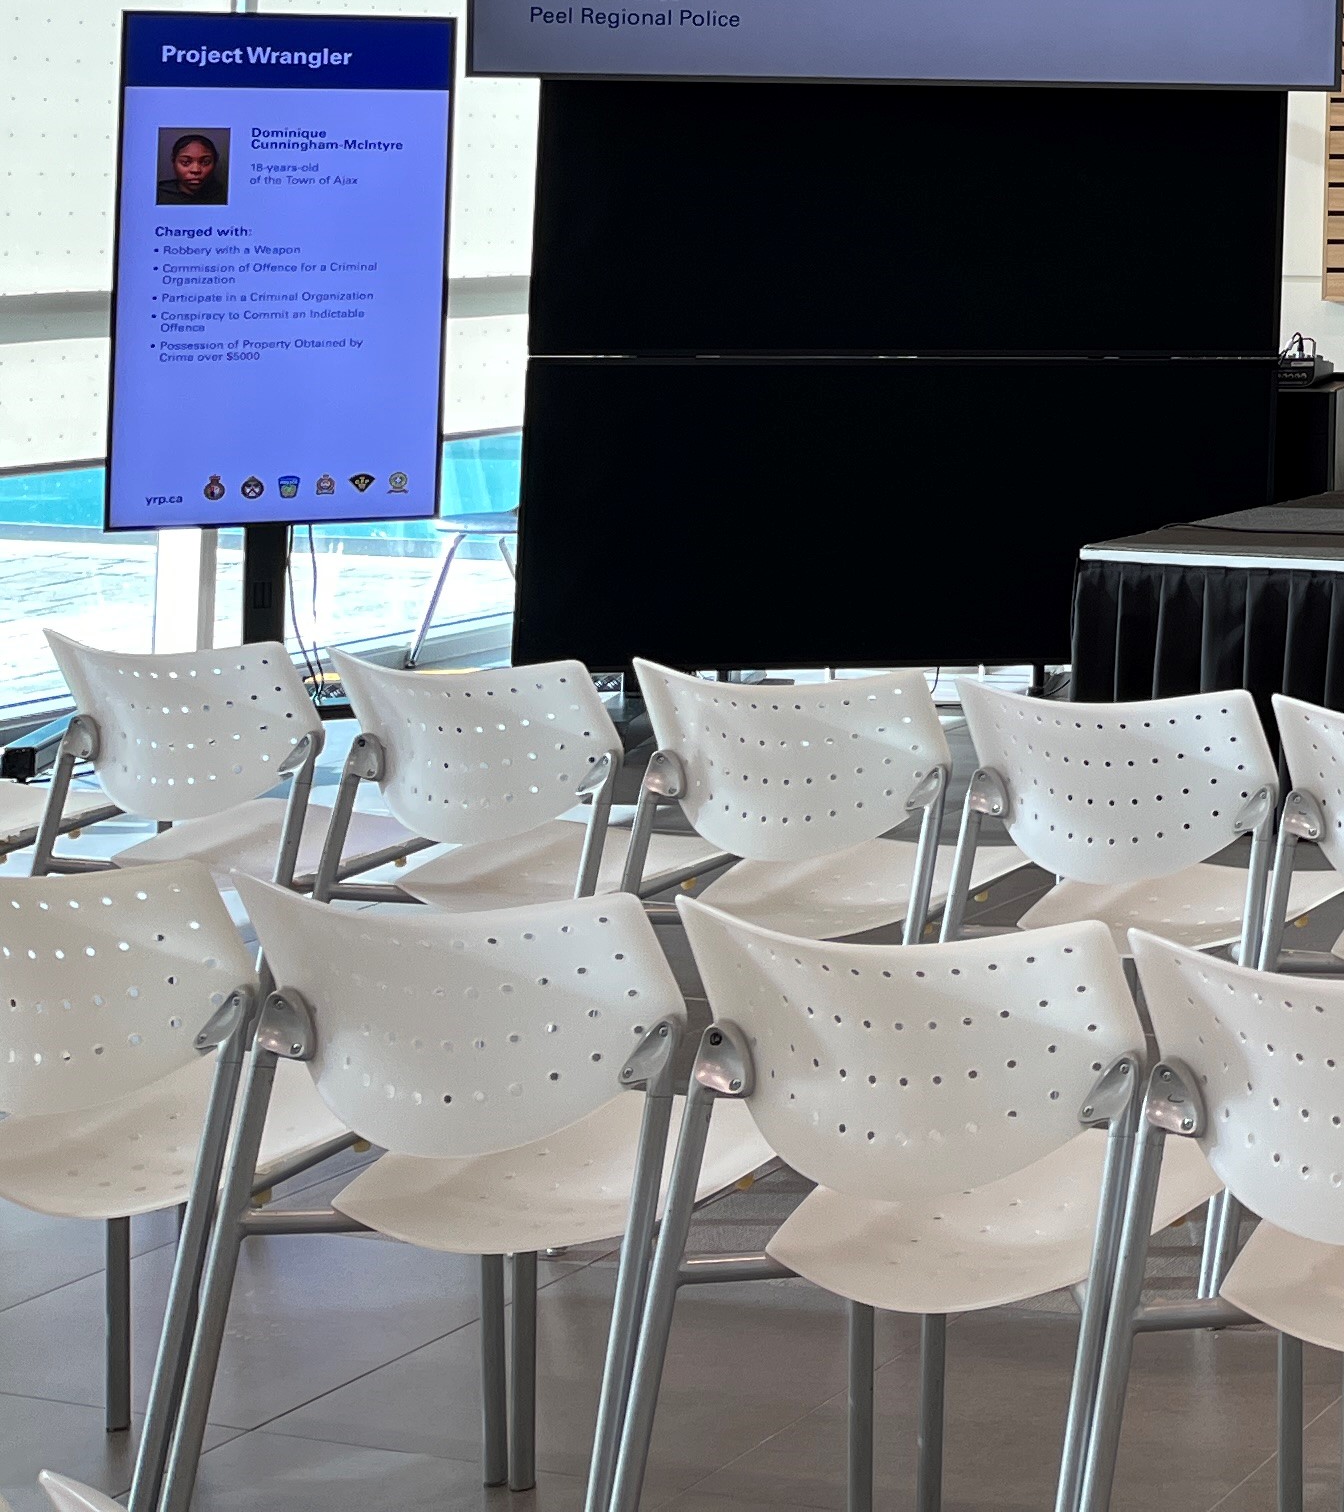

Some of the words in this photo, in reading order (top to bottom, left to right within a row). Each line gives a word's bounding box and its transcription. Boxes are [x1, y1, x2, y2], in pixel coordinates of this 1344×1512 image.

[530, 7, 574, 25] Peel
[581, 8, 672, 30] Regional
[680, 10, 740, 29] Police
[161, 45, 243, 67] Project
[247, 46, 353, 69] Wrangler
[251, 127, 327, 140] Dominique
[251, 139, 403, 152] Cunningham-McIntyre
[250, 176, 261, 185] of
[264, 176, 283, 185] the
[286, 176, 316, 185] Town
[319, 176, 331, 185] of
[333, 176, 358, 187] Ajax
[155, 226, 212, 239] Charged
[217, 226, 252, 237] with:
[163, 245, 212, 256] Robbery
[215, 245, 240, 255] with
[244, 247, 250, 255] a
[254, 245, 301, 256] Weapon
[162, 263, 235, 273] Commission
[238, 263, 251, 273] of
[253, 263, 298, 273] Offence
[300, 262, 316, 272] for
[329, 262, 378, 272] Criminal
[162, 275, 236, 287] Organization
[161, 293, 222, 304] Participate
[225, 293, 237, 302] in
[240, 294, 247, 302] a
[250, 292, 298, 302] Criminal
[301, 292, 374, 303] Organization
[160, 311, 224, 322] Conspiracy
[228, 312, 240, 320] to
[243, 310, 289, 320] Commit
[292, 311, 306, 319] an
[310, 309, 365, 319] Indictable
[160, 323, 205, 333] Offence
[160, 340, 224, 350] Possession
[227, 340, 240, 350] of
[242, 340, 291, 351] Property
[294, 339, 346, 349] Obtained
[349, 338, 364, 349] by
[159, 353, 194, 363] Crime
[197, 354, 223, 362] over
[226, 351, 260, 362] $5000
[145, 494, 183, 506] yrp.ca
